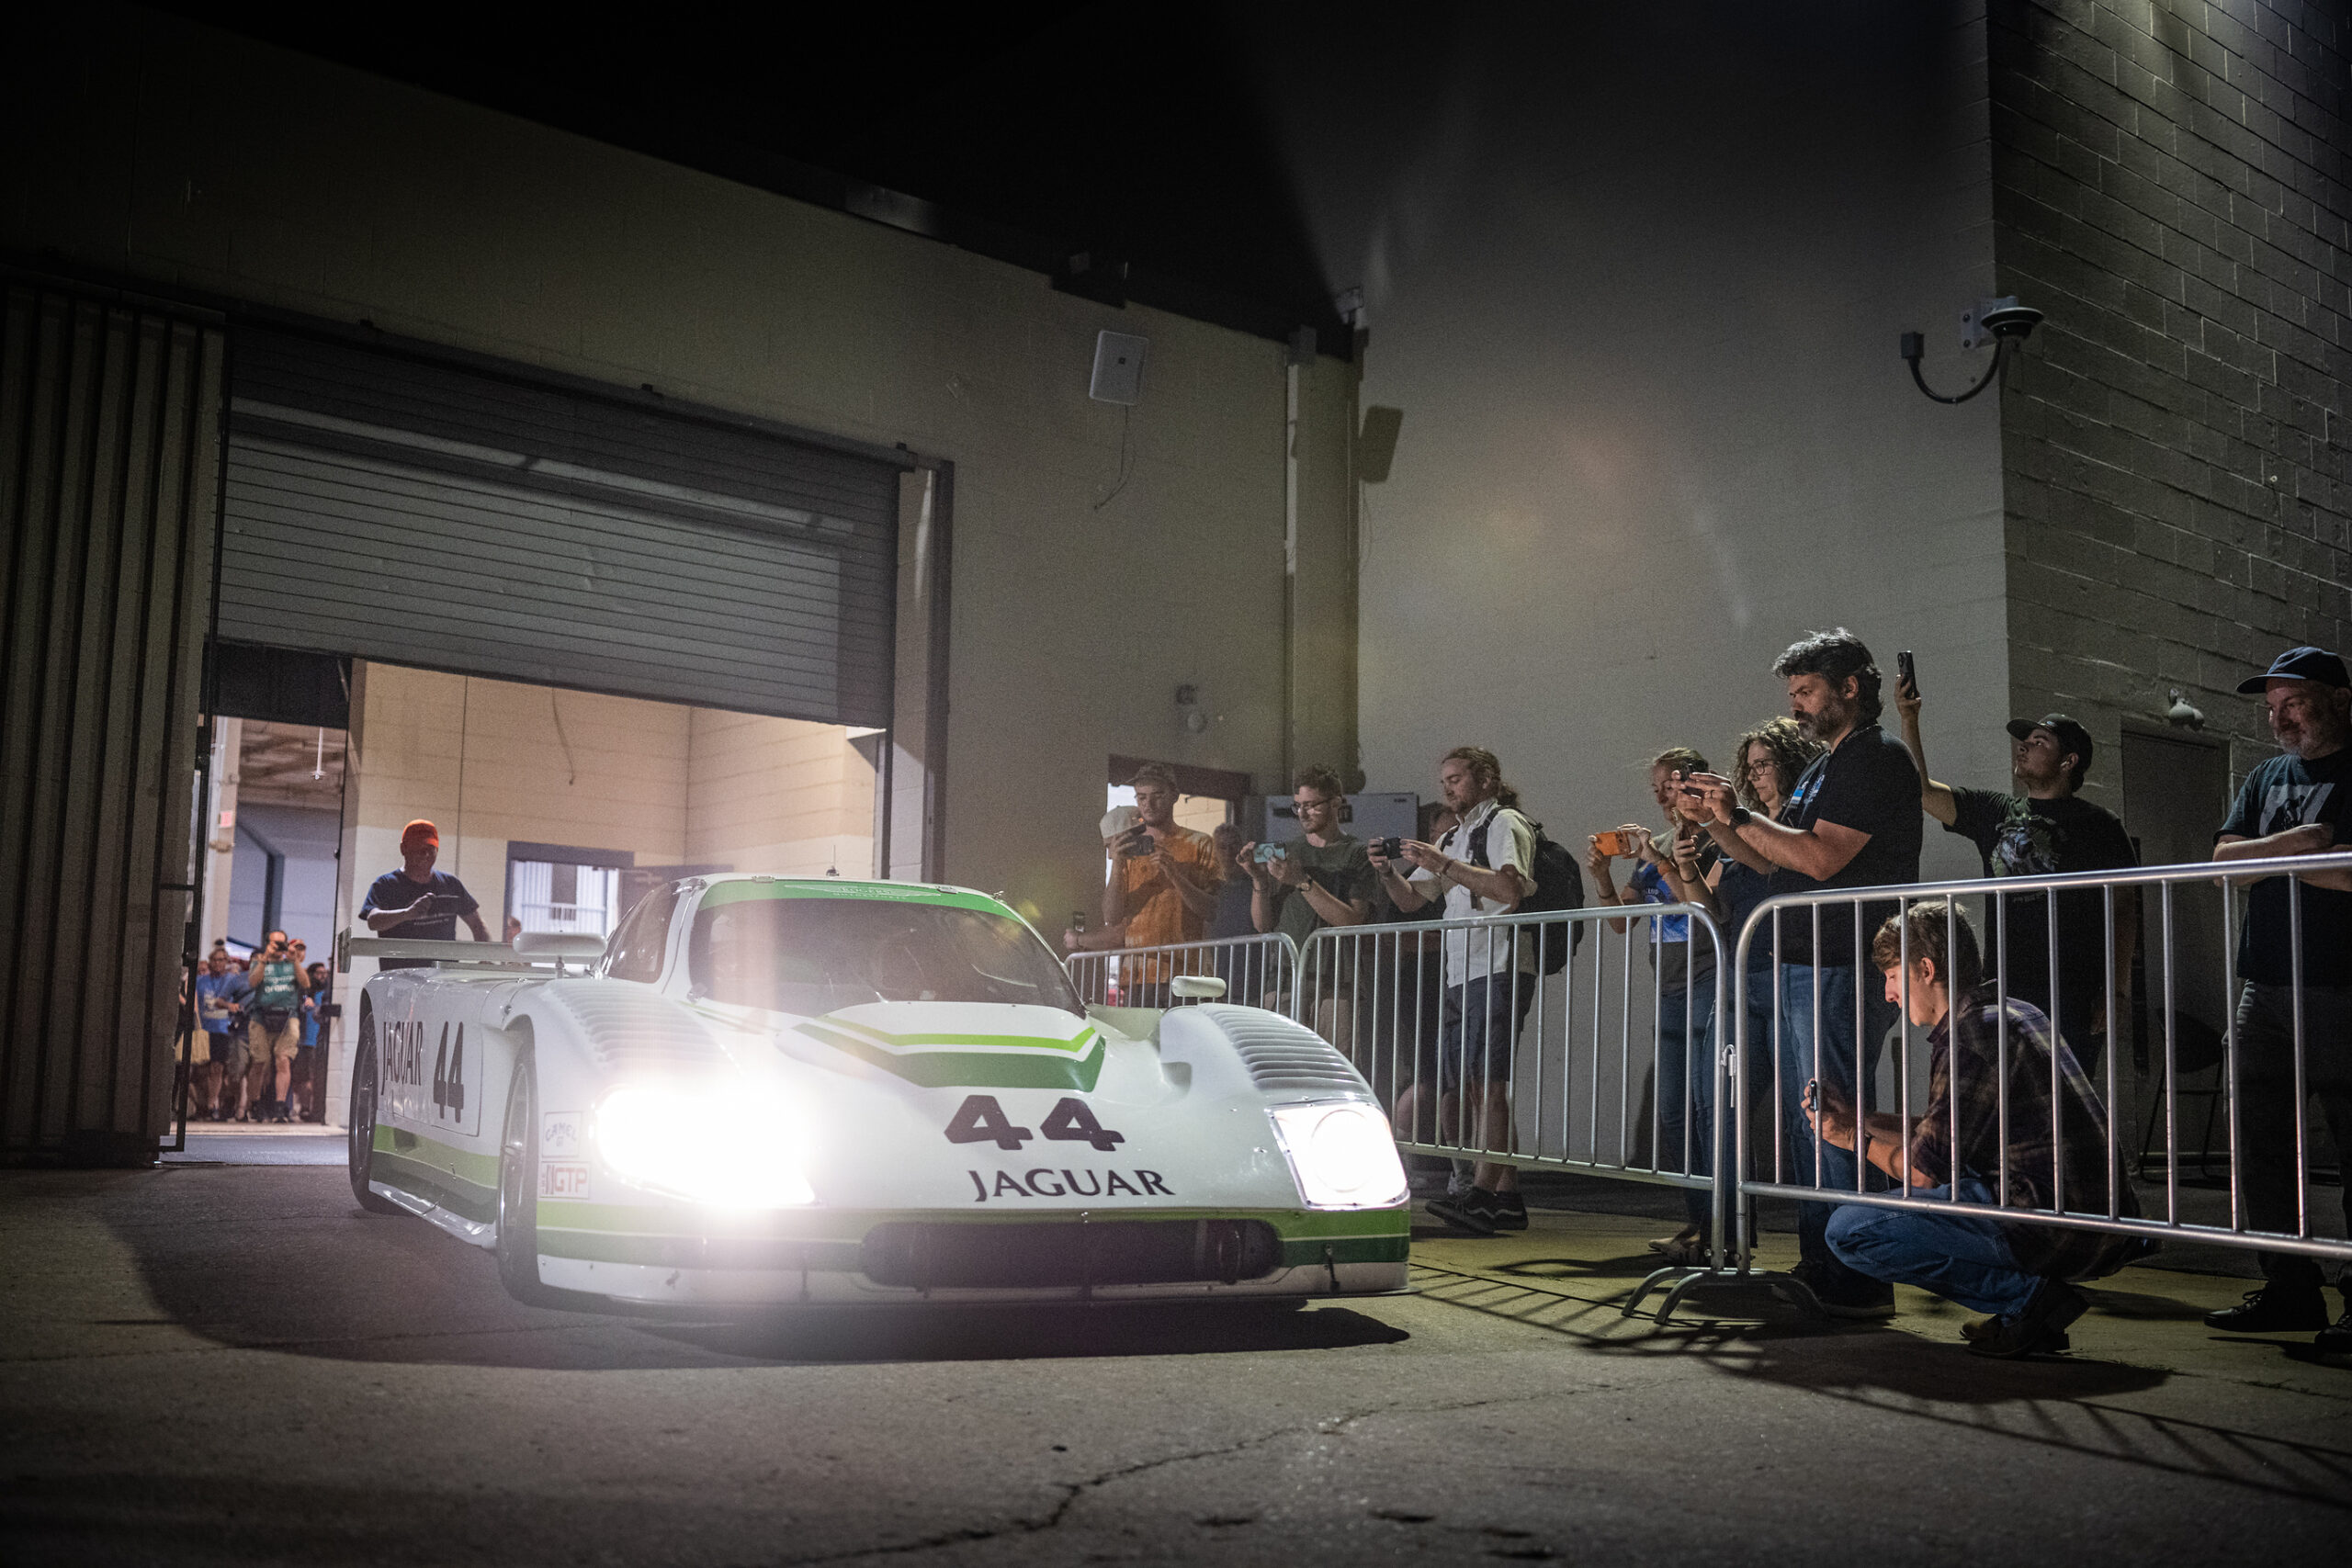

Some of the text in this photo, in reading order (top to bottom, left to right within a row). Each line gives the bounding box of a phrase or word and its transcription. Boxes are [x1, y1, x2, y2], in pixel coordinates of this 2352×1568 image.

[380, 1021, 464, 1123] JAGUAR 44
[545, 1122, 577, 1142] CAMEL
[944, 1094, 1125, 1152] 44
[554, 1167, 588, 1193] GTP
[967, 1168, 1176, 1202] JAGUAR
